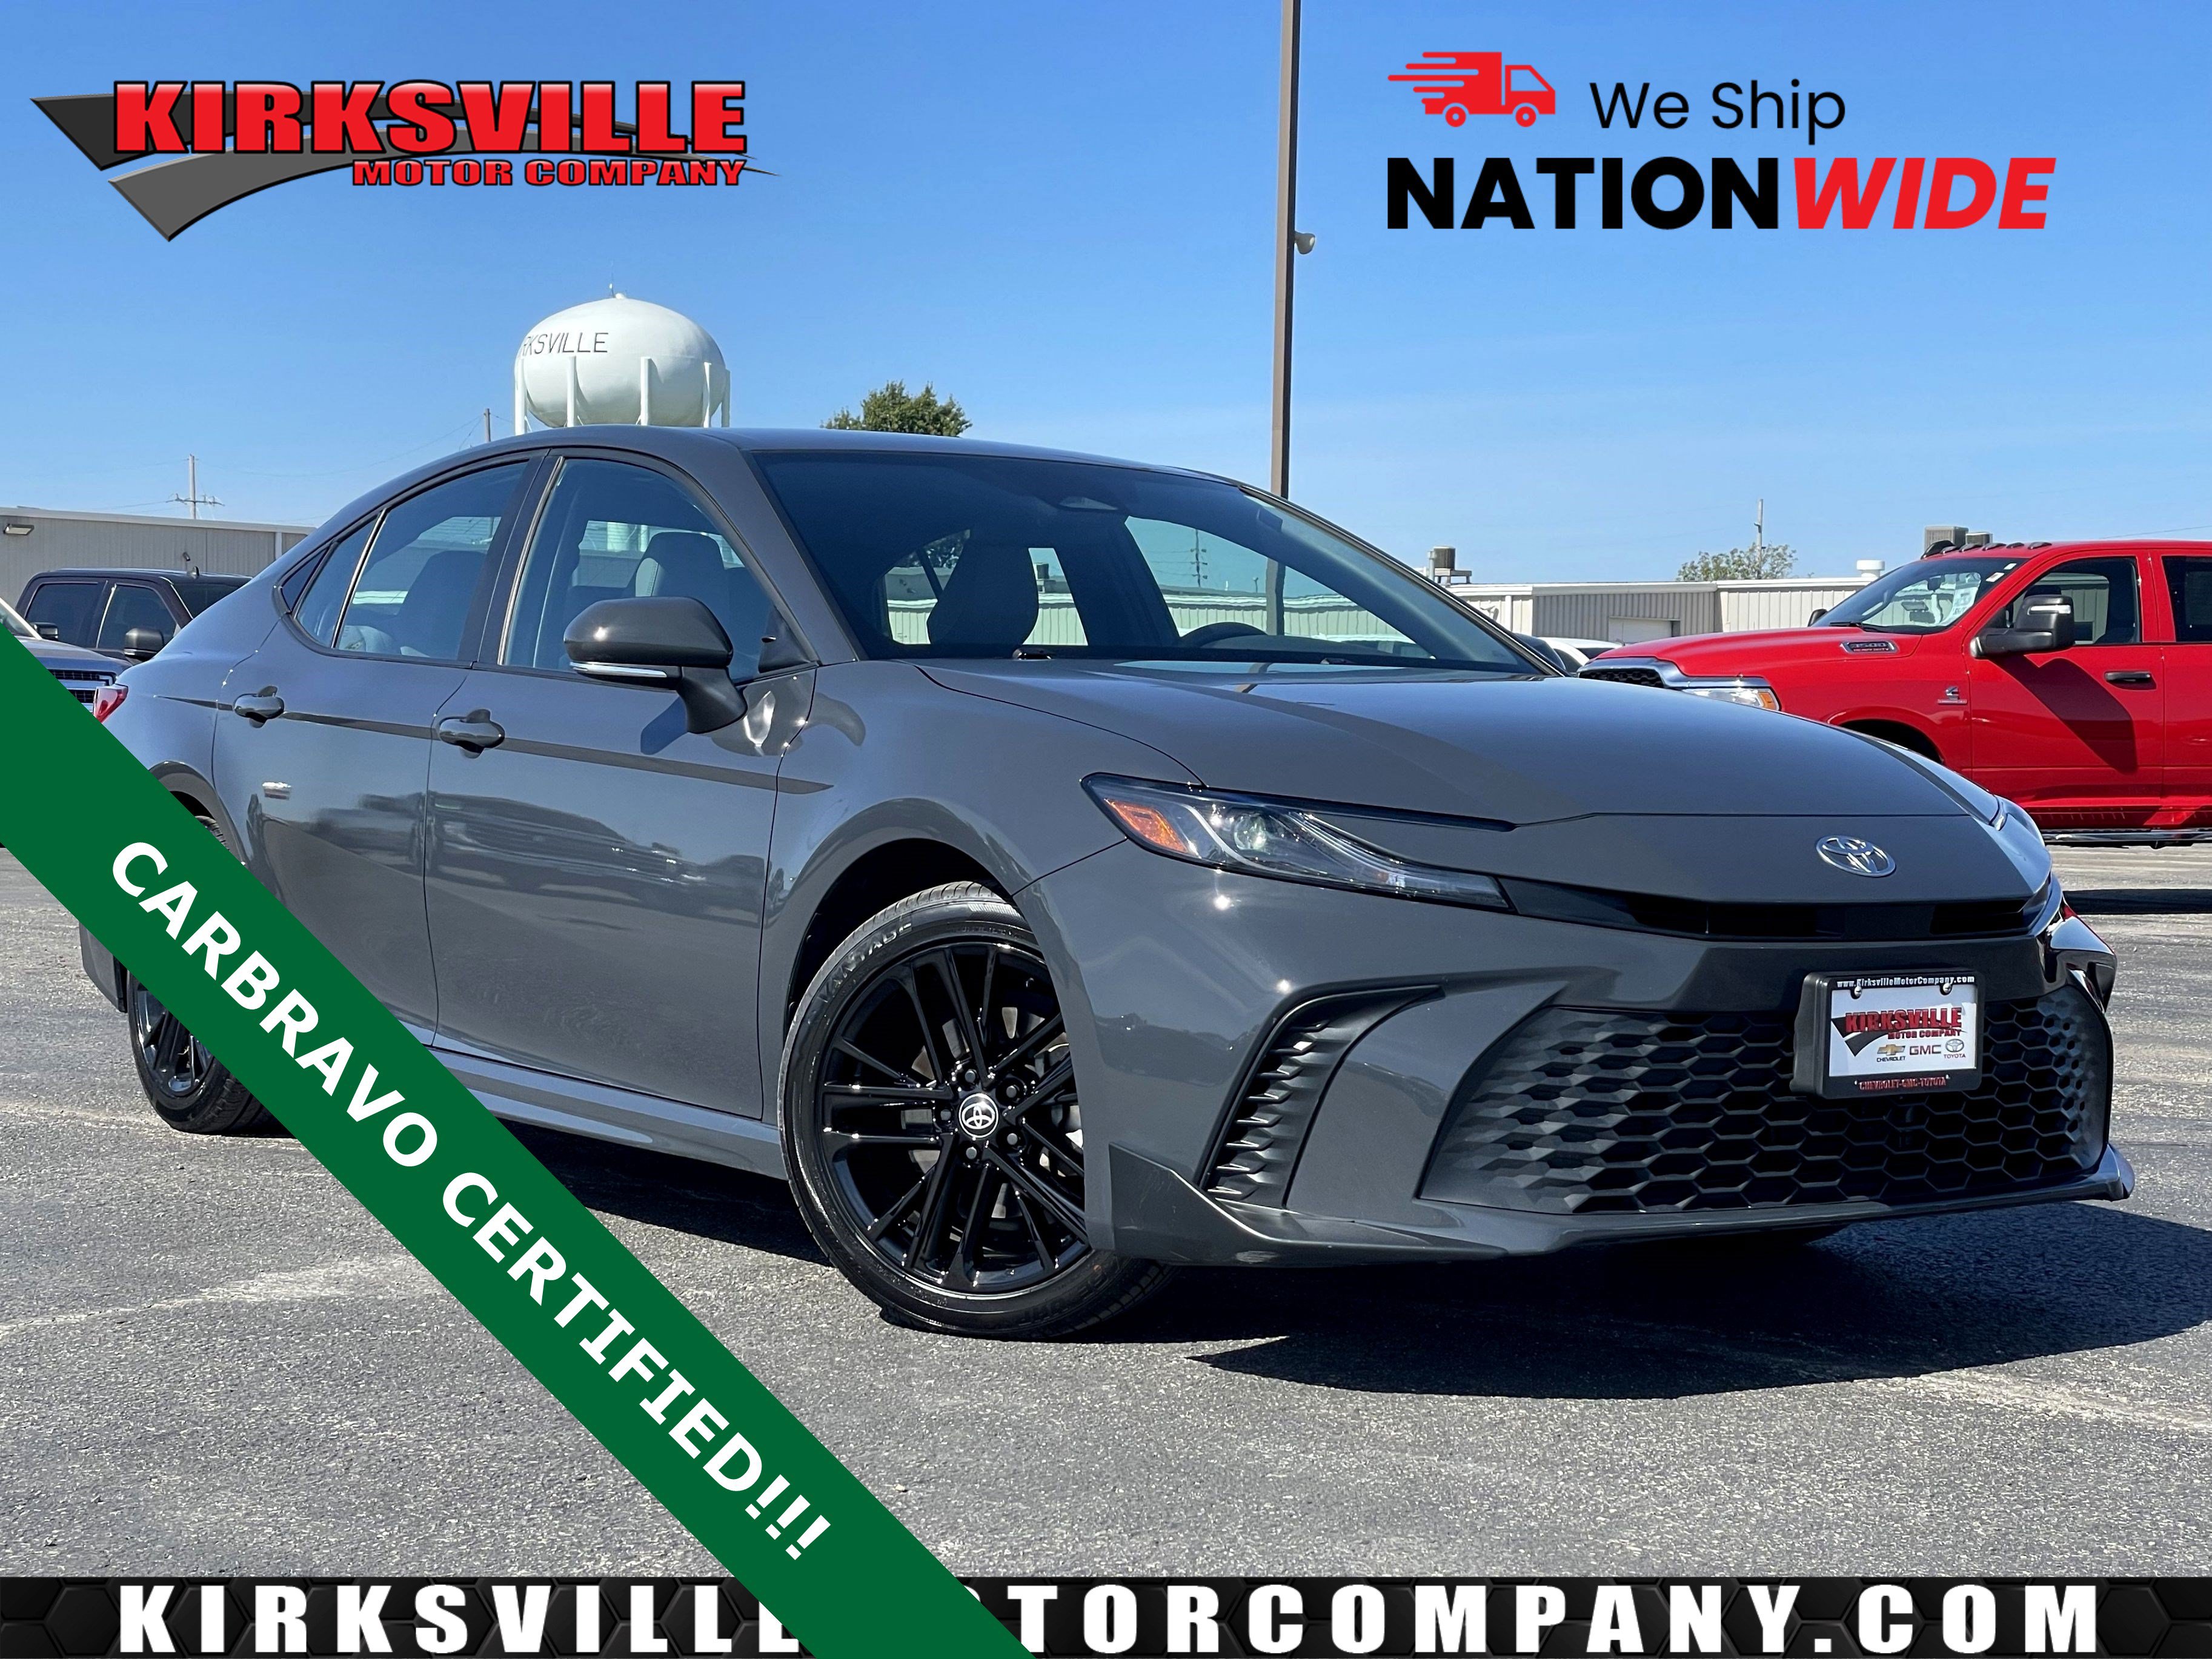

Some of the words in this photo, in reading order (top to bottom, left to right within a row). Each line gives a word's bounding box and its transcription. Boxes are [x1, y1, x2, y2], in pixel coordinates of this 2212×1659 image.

[1837, 976, 1975, 988] www.KirksvilleMotorCompany.com
[1845, 1007, 1962, 1033] KIRKSVILLE
[1887, 1031, 1918, 1040] MOTOR
[1919, 1029, 1961, 1039] COMPANY
[1909, 1045, 1942, 1056] GMC
